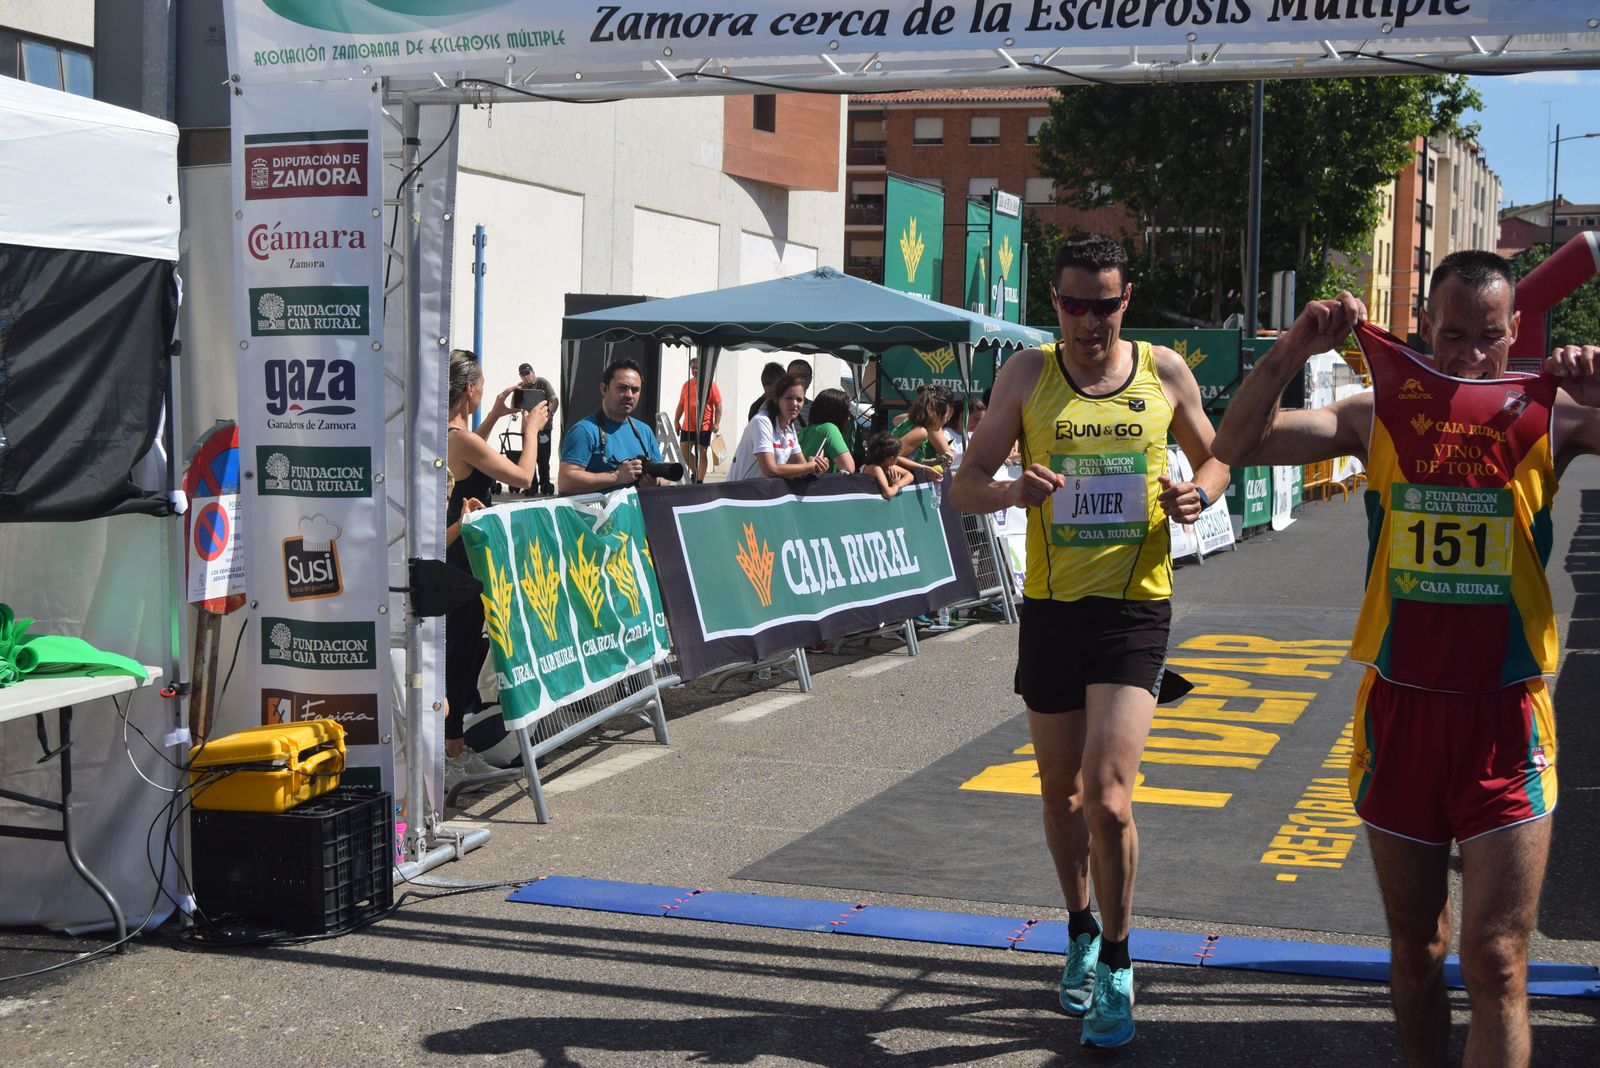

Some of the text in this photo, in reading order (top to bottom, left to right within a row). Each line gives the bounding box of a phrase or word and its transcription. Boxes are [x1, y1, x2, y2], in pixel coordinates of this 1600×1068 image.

[590, 5, 758, 42] Zamora
[769, 8, 888, 37] cerca
[903, 0, 955, 36] de
[969, 0, 1012, 33] la
[1024, 0, 1251, 31] Esclerosis
[254, 29, 565, 66] ASOCIACIÓN ZAMORANA DE ESCLEROSIS MÚLTIPLE
[272, 153, 360, 168] DIPUTACIÓN DE
[271, 167, 361, 188] ZAMORA
[289, 259, 325, 269] Zamora
[287, 304, 361, 317] FUNDACION
[287, 317, 361, 330] CAJA RURAL
[264, 359, 356, 416] gaza
[1199, 385, 1230, 399] RAL
[267, 419, 356, 430] Ganaderos de Zamora
[1056, 420, 1143, 440] RUN & GO
[1435, 421, 1506, 442] CAJA RURAL
[1432, 443, 1482, 459] VINO
[1079, 457, 1134, 467] FUNDACION
[1416, 460, 1498, 477] DE TORO
[291, 466, 364, 479] FUNDACION
[1079, 465, 1135, 475] CAJA RURAL
[291, 480, 363, 492] CAJA RURAL
[1075, 479, 1081, 490] 6
[1425, 490, 1498, 503] FUNDACION
[1072, 492, 1123, 518] JAVIER
[1424, 501, 1498, 513] CAJA RURAL
[1079, 529, 1143, 540] CAJA RURAL
[1408, 520, 1487, 567] 151
[781, 527, 920, 596] CAJA RURAL
[288, 553, 333, 585] Susi
[1420, 581, 1502, 595] CAJA RURAL
[292, 638, 368, 652] FUNDACION
[292, 652, 368, 664] CAJA RURAL
[1260, 777, 1363, 868] REFORMA
